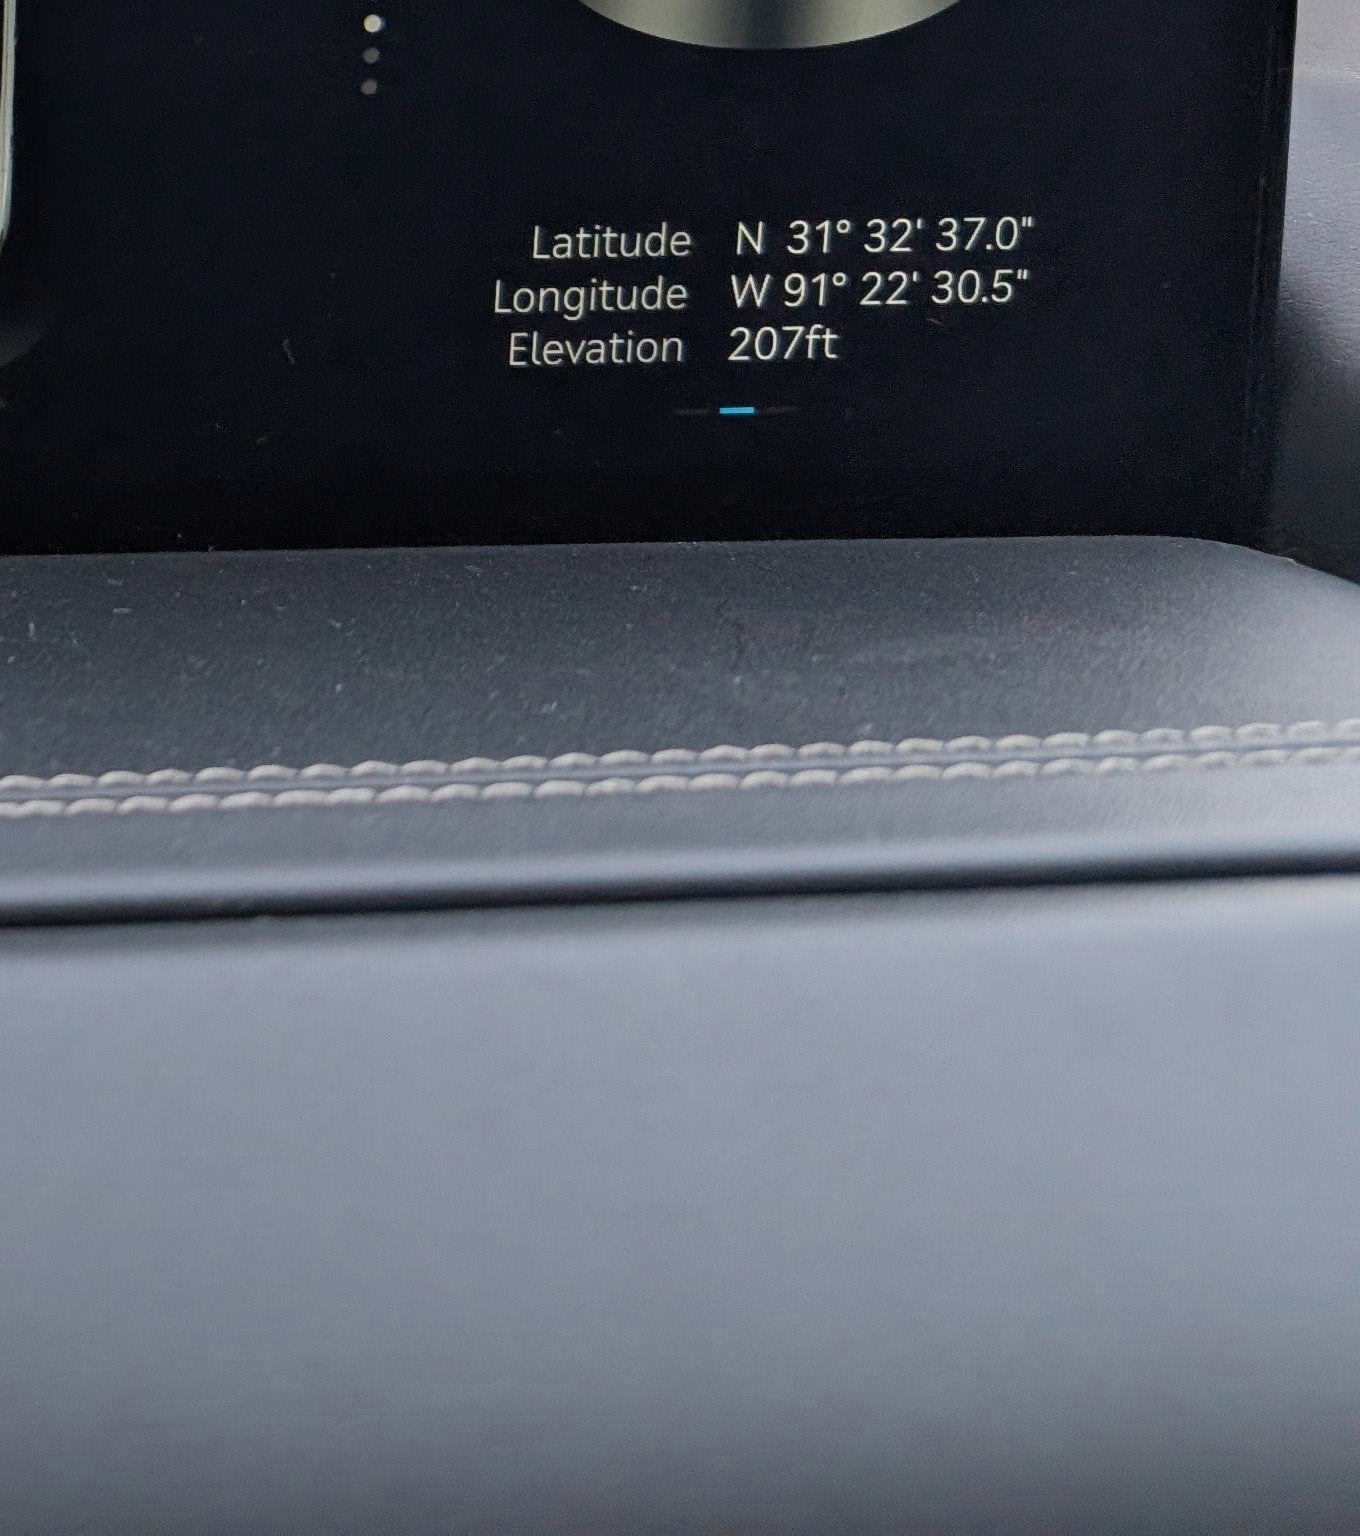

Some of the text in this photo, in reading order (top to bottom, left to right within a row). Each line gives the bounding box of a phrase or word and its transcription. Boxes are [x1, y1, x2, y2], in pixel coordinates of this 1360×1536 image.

[532, 221, 692, 259] Latitude
[736, 220, 765, 256] N
[786, 218, 852, 255] 31°
[493, 274, 689, 321] Longitude
[730, 273, 771, 309] W
[784, 271, 848, 308] 91°
[508, 323, 840, 366] Elevation 207ft
